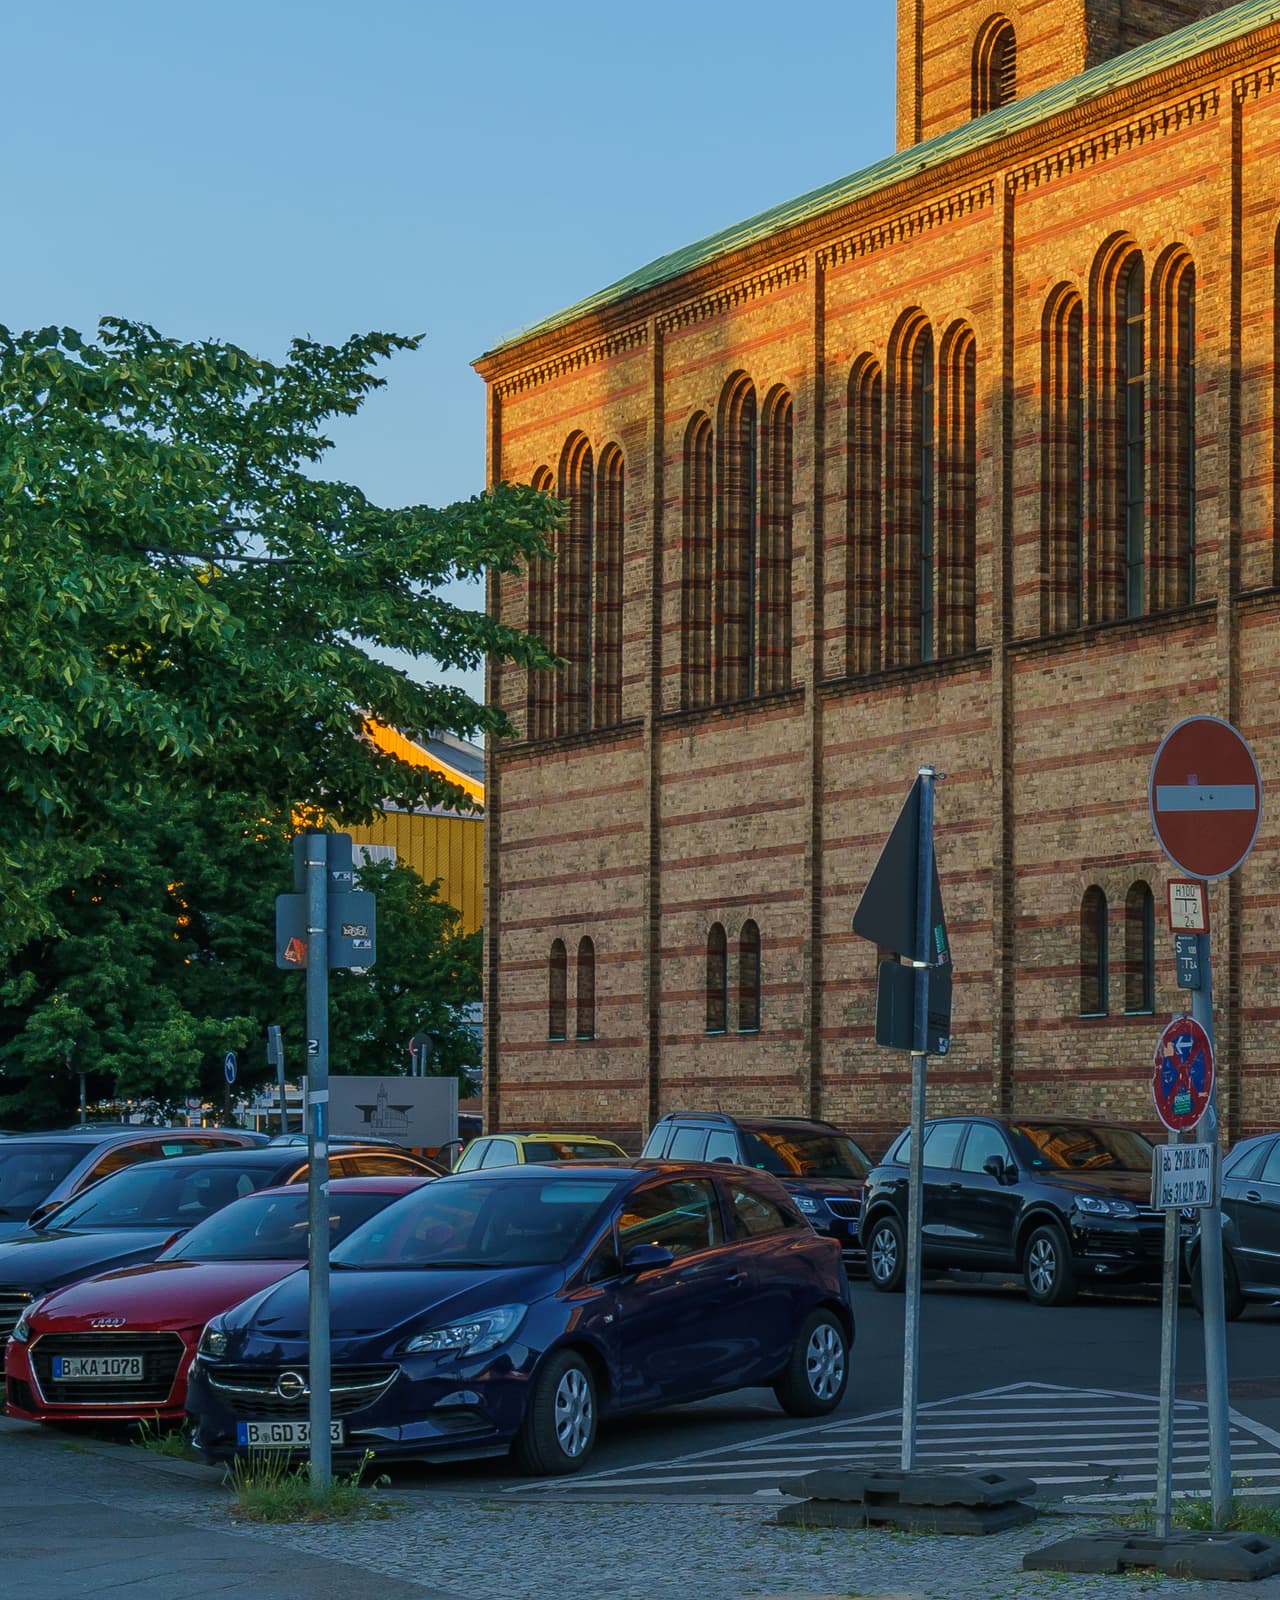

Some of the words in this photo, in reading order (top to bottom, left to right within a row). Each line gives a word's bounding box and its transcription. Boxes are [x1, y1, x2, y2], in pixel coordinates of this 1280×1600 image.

[1175, 885, 1195, 896] H100
[1176, 941, 1182, 952] S
[1163, 1152, 1171, 1171] ab
[1163, 1183, 1173, 1203] bis
[62, 1360, 71, 1375] B
[80, 1359, 98, 1375] KA
[102, 1358, 140, 1375] 1078
[248, 1425, 259, 1442] B
[271, 1424, 293, 1442] GD
